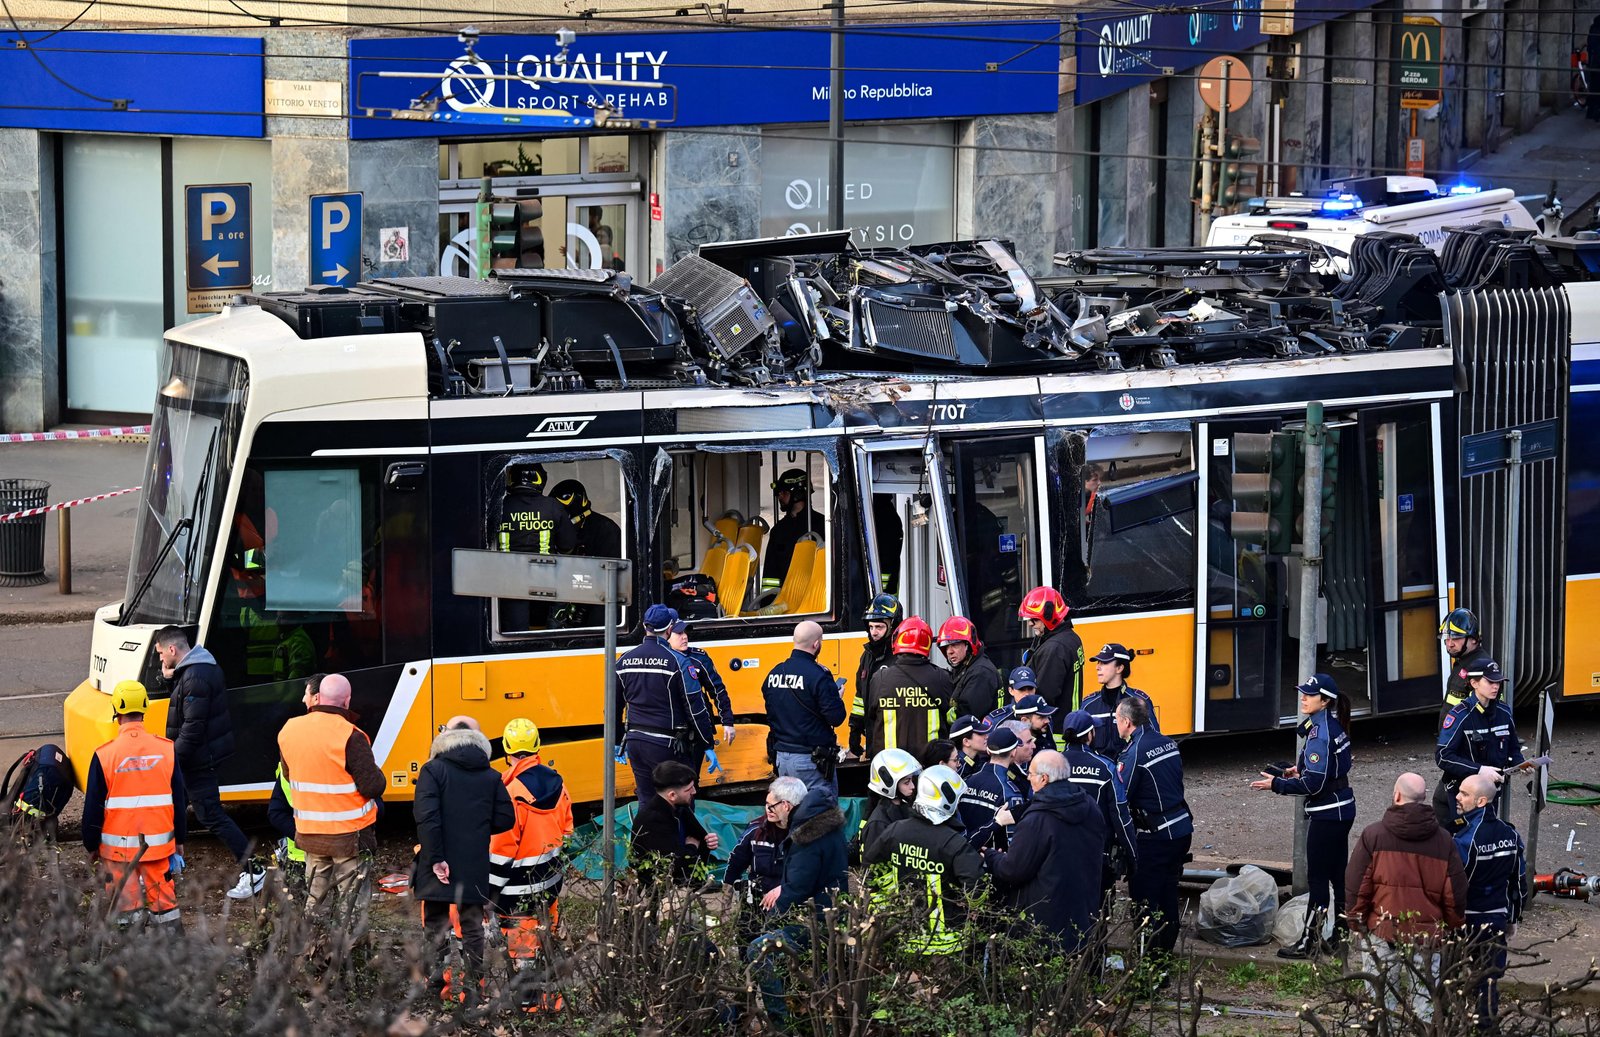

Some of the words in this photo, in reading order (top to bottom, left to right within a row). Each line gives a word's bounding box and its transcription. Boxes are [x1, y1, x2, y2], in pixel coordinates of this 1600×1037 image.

[1116, 14, 1153, 53] QUALITY
[516, 50, 668, 90] QUALITY
[812, 86, 857, 100] Milno
[860, 82, 933, 102] Repubblica
[267, 98, 304, 107] VITTORIO
[308, 100, 339, 108] VENETO
[517, 94, 579, 110] SPORT
[605, 92, 668, 108] REHAB
[201, 192, 236, 241] P
[321, 201, 351, 250] P
[228, 231, 245, 240] ore
[927, 403, 967, 421] 7707
[547, 421, 575, 432] ATM
[510, 511, 541, 522] VIGILI
[519, 520, 554, 531] FUOCO
[93, 654, 108, 673] 7707
[622, 657, 644, 667] POLIZIA
[644, 657, 669, 667] LOCALE
[767, 674, 805, 690] POLIZIA
[895, 686, 928, 698] VIGILI
[879, 697, 901, 708] DEL
[905, 697, 942, 708] FUOCO
[411, 762, 419, 772] B
[1072, 765, 1101, 776] LOCALE
[899, 842, 929, 860] VIGILI
[890, 852, 902, 866] EL
[905, 855, 945, 874] FUOCO
